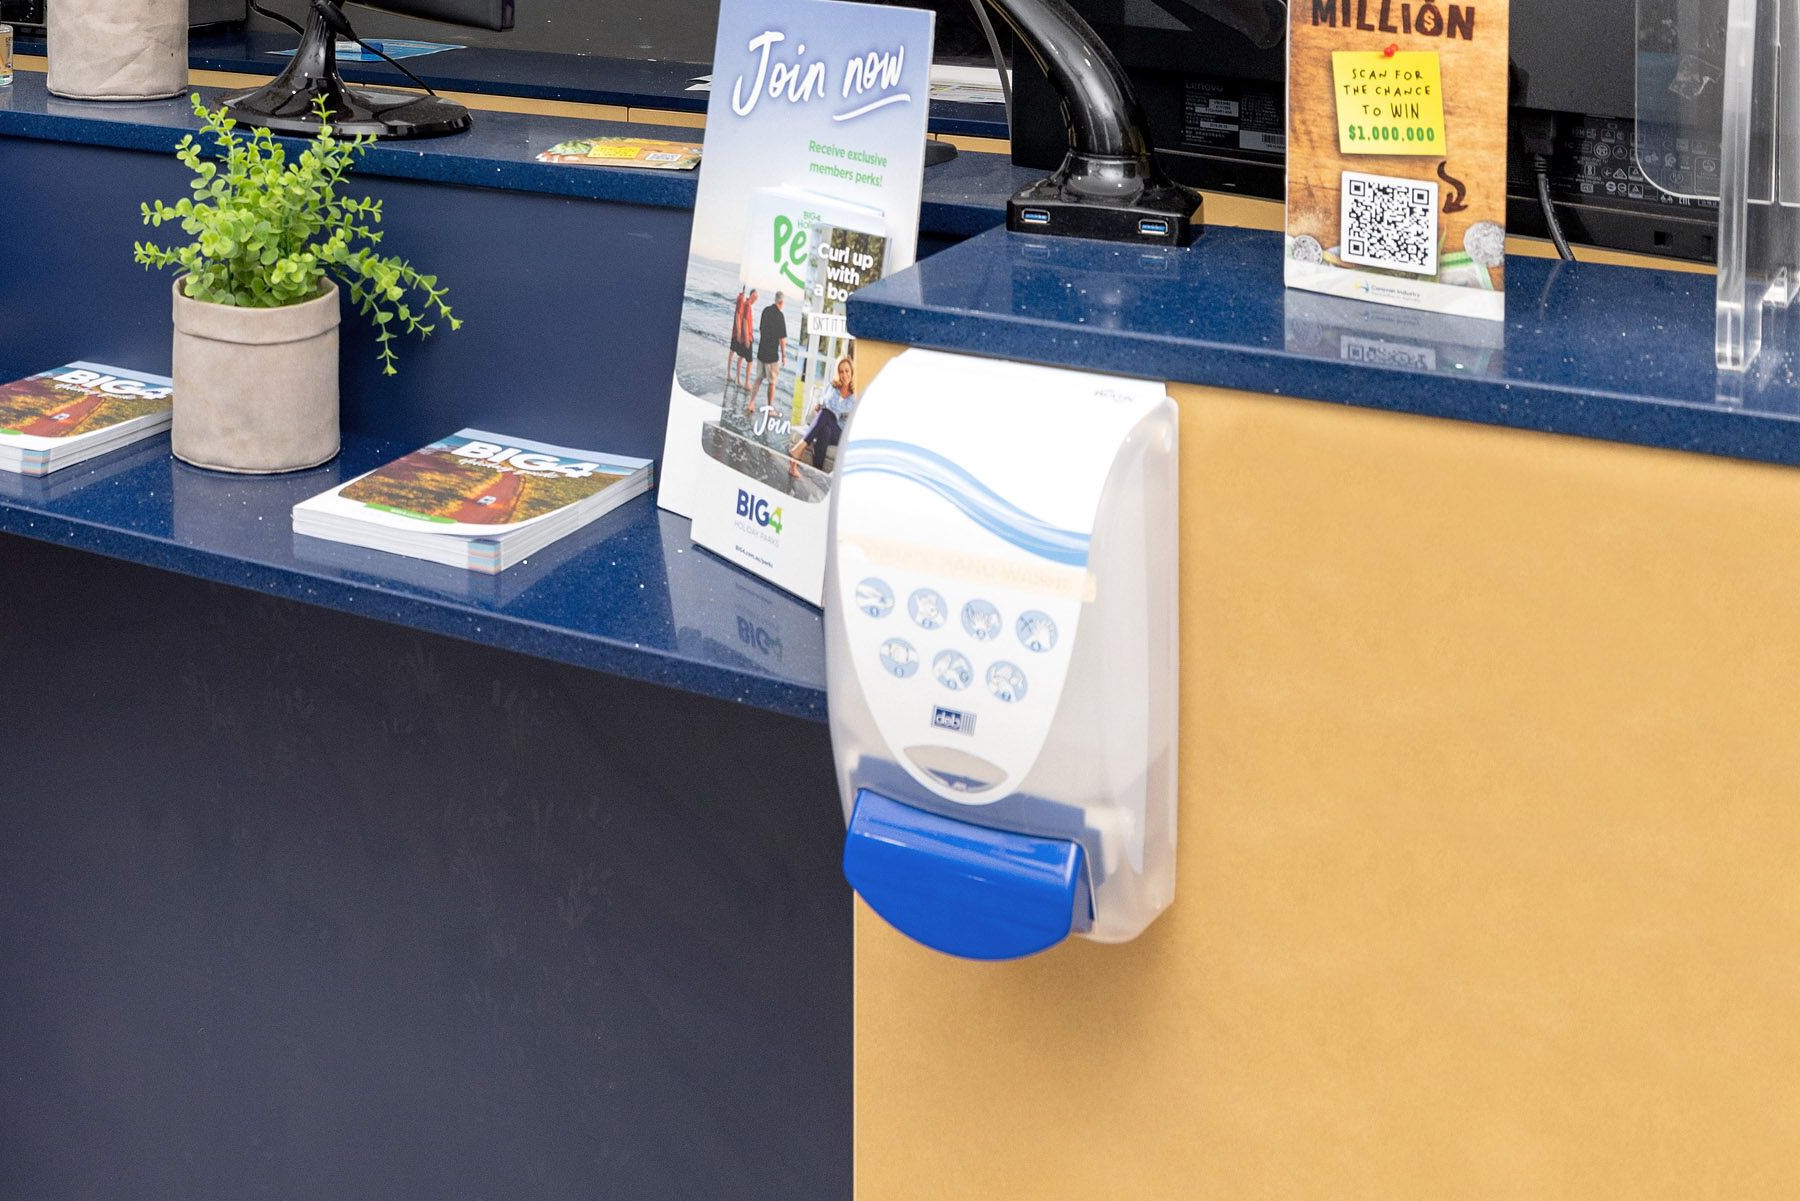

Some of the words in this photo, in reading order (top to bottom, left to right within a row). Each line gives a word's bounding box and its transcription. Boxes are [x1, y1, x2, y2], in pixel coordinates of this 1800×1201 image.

[732, 30, 826, 116] Join
[842, 45, 905, 98] now
[1352, 68, 1388, 81] SCAN
[1395, 70, 1423, 81] FOR
[1343, 84, 1369, 96] THE
[1373, 85, 1431, 97] CHANCE
[1362, 104, 1382, 117] TO
[1391, 102, 1420, 120] WIN
[808, 140, 846, 159] Receive
[847, 149, 888, 168] exclusive
[809, 161, 854, 181] members
[855, 171, 883, 187] perks!
[818, 243, 850, 264] Curl
[852, 252, 874, 271] up
[827, 266, 860, 285] with
[814, 283, 824, 296] a
[53, 369, 173, 400] BIG4
[754, 404, 791, 436] Join
[451, 441, 600, 478] BIG4
[736, 488, 782, 535] BIG4
[936, 711, 960, 730] deb
